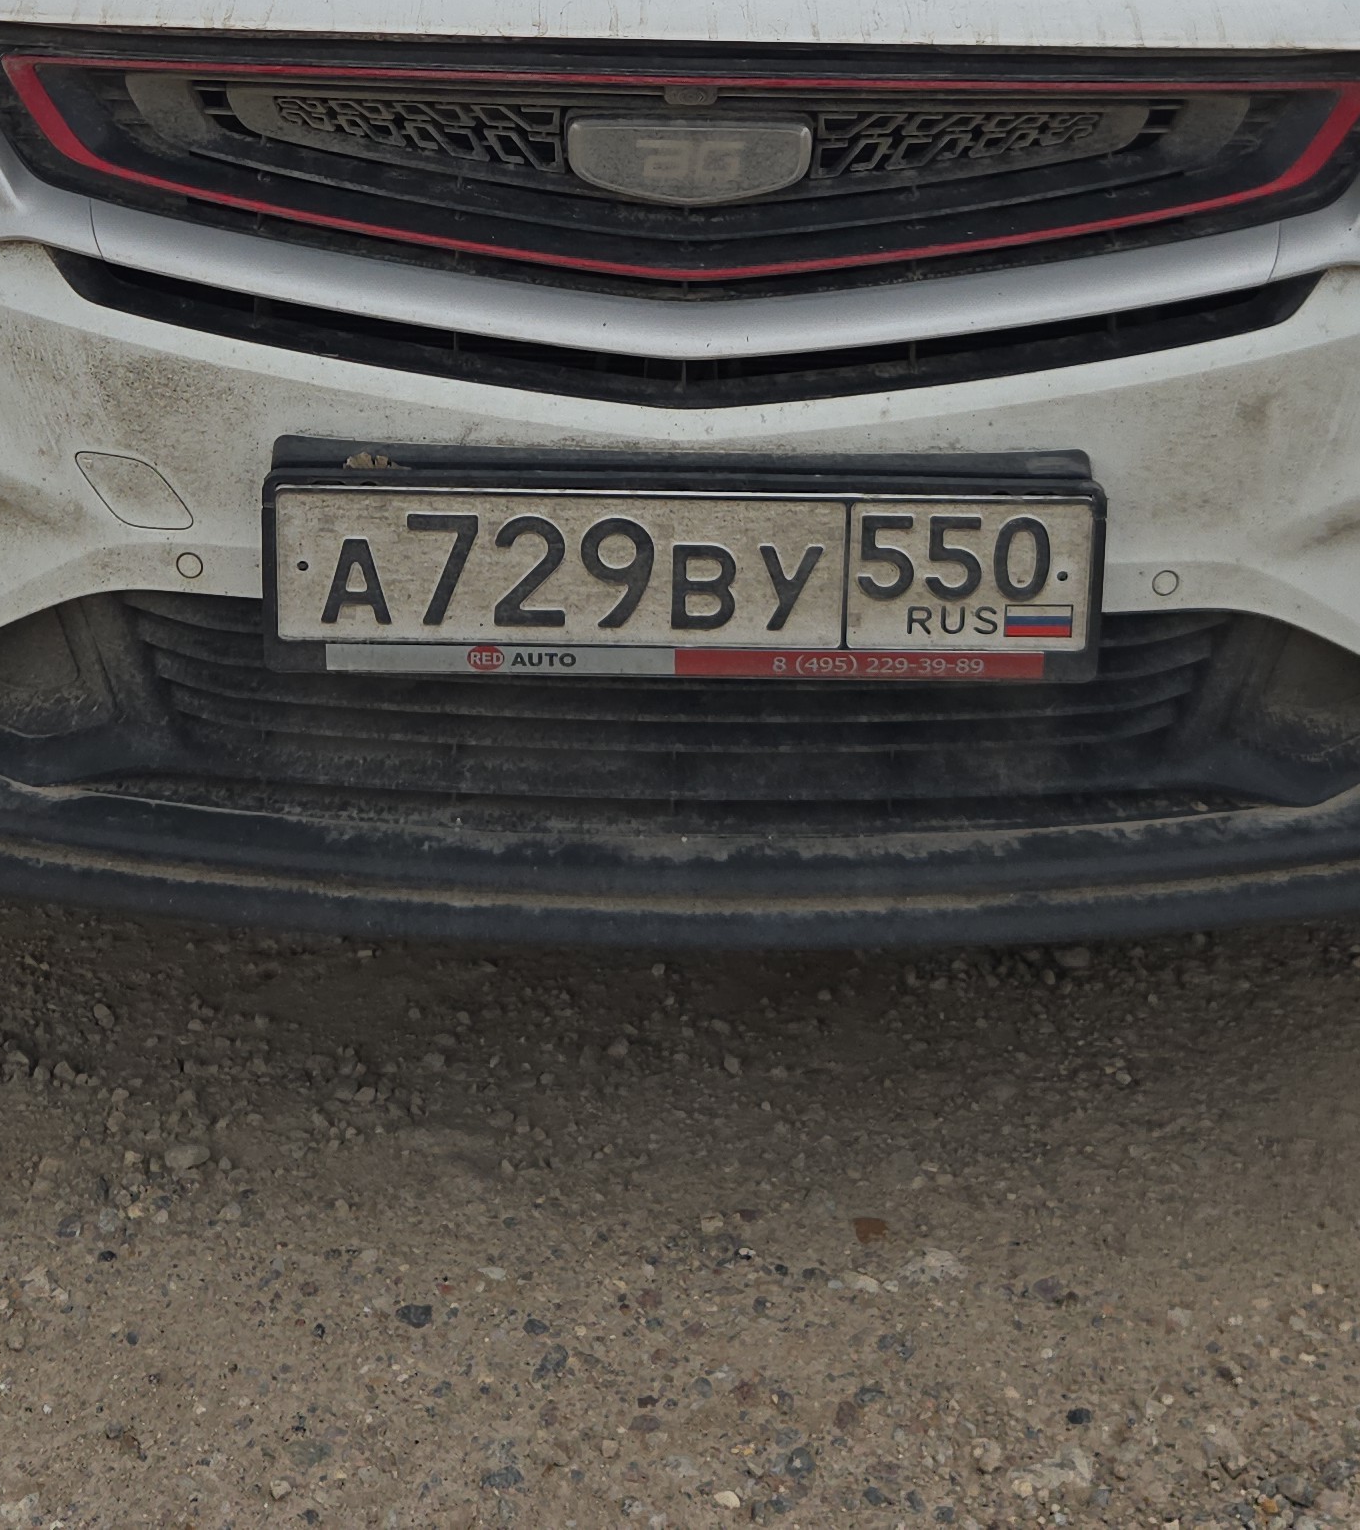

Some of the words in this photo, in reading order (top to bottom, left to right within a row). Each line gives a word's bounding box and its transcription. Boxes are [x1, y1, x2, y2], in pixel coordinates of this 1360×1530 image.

[857, 515, 1051, 601] 550
[907, 606, 998, 635] RUS
[469, 650, 504, 666] RED
[510, 652, 577, 668] AUTO
[772, 656, 787, 673] 8
[795, 654, 858, 675] (495)
[866, 657, 985, 674] 229-39-89
